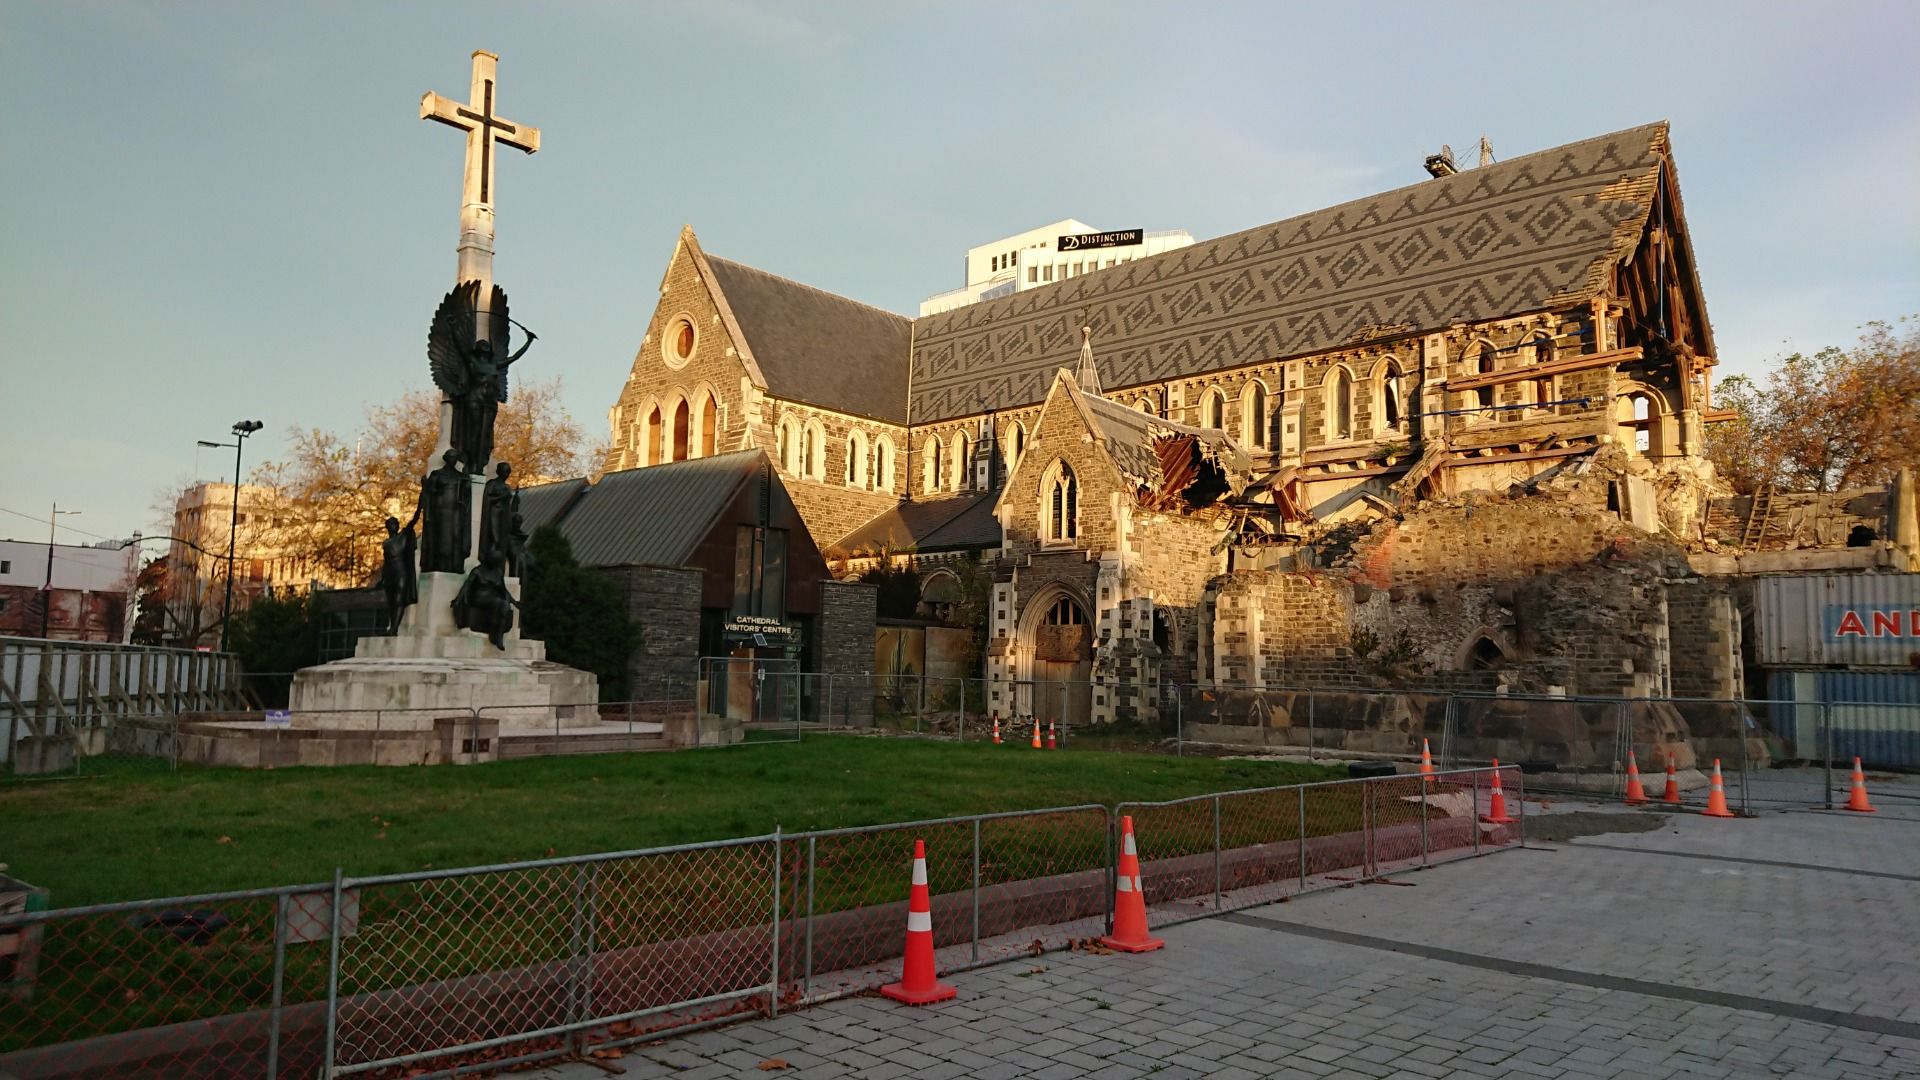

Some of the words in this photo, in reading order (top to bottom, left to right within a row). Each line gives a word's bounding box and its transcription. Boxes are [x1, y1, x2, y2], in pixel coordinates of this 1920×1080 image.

[1081, 232, 1135, 244] DISTINCTION
[736, 616, 780, 625] CATHEDRAL
[724, 623, 761, 632] VISITORS'
